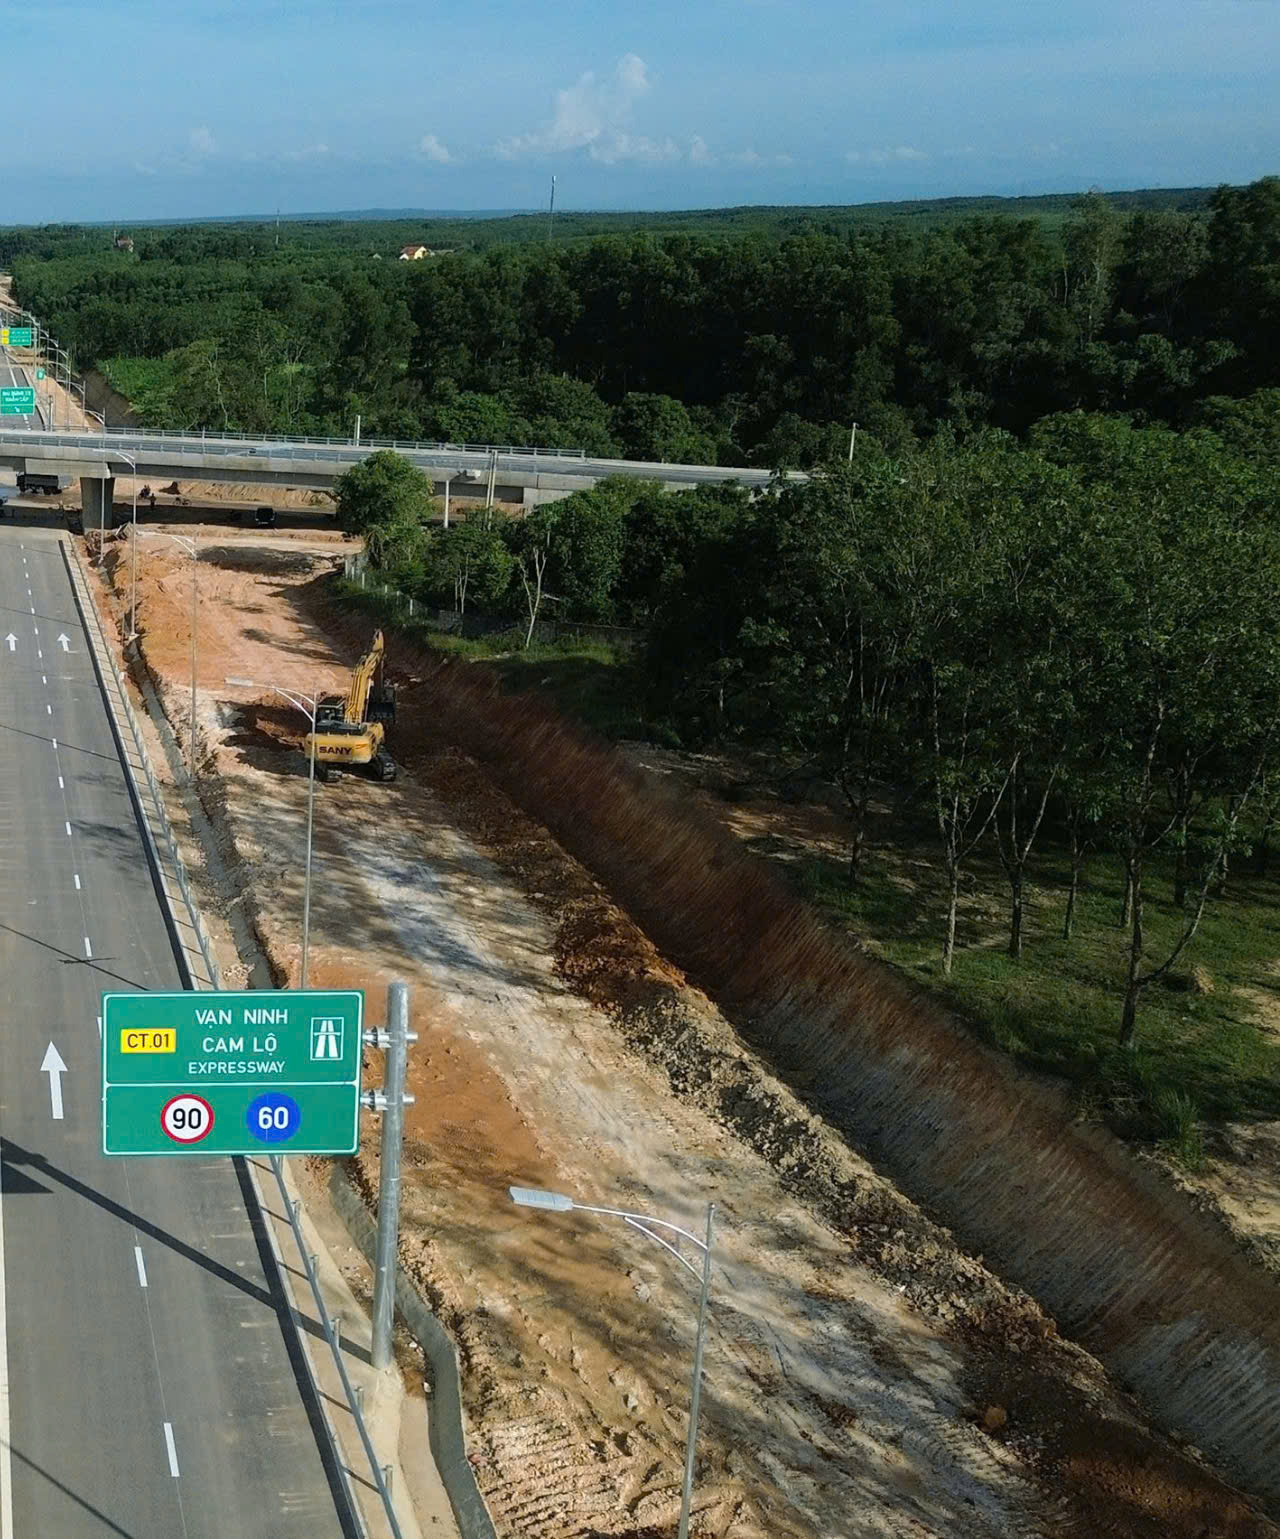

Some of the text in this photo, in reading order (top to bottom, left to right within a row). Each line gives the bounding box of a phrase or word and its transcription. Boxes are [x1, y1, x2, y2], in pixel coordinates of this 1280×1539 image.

[319, 746, 352, 754] SANY
[195, 1008, 288, 1029] VẠN NINH
[126, 1033, 171, 1049] CT.01
[202, 1033, 277, 1056] CAM LỘ
[188, 1061, 285, 1075] EXPRESSWAY
[172, 1108, 202, 1130] 90
[258, 1107, 289, 1130] 60
